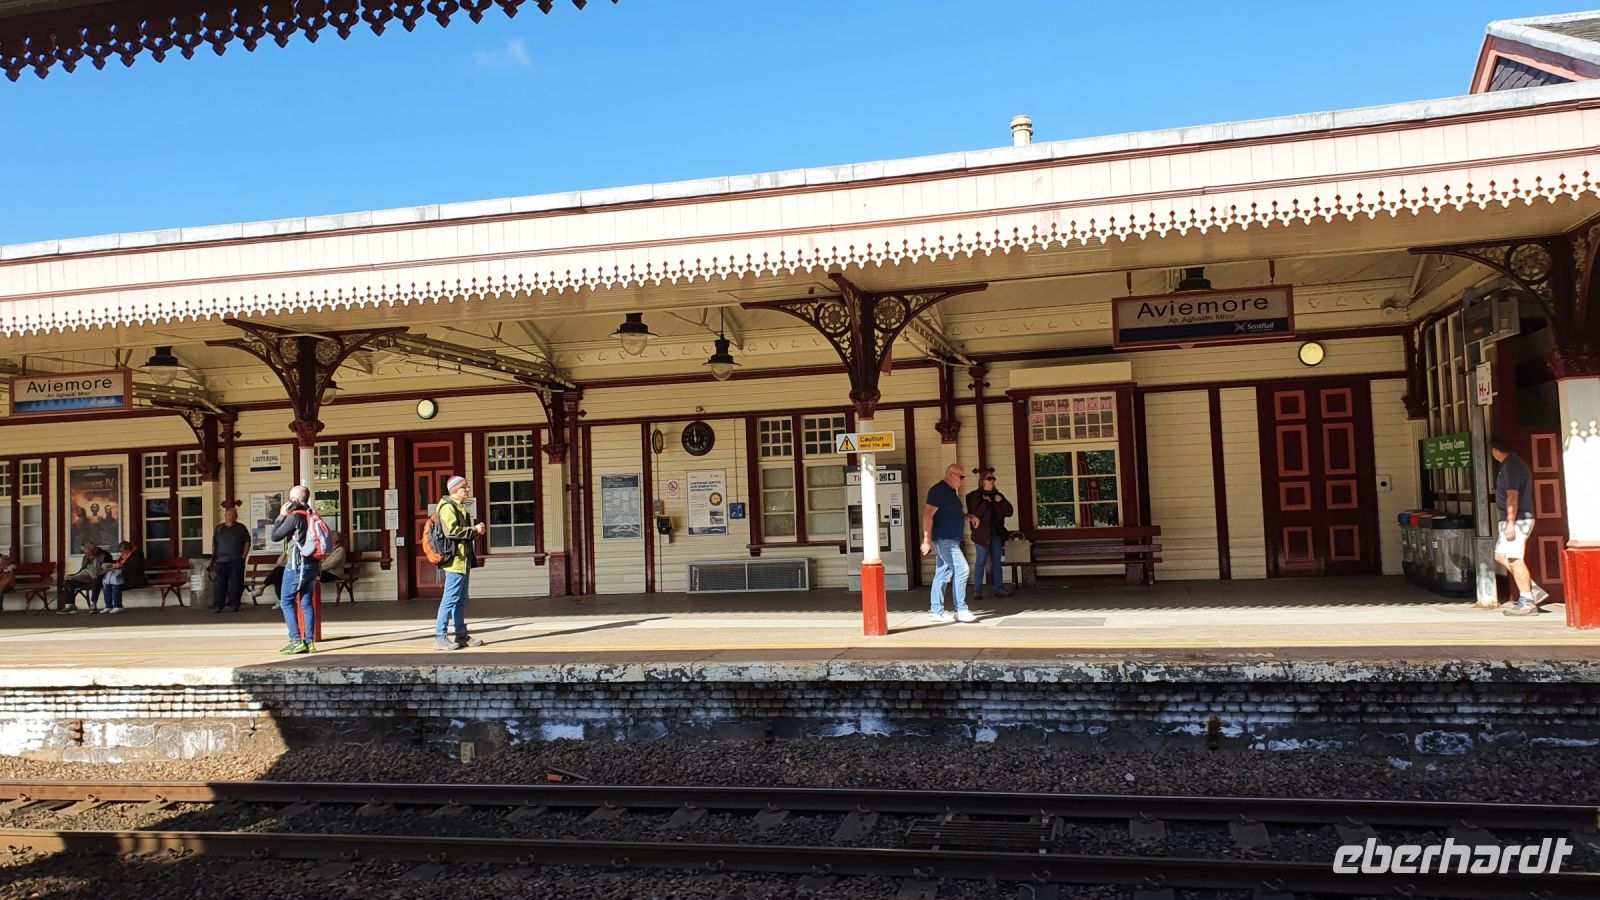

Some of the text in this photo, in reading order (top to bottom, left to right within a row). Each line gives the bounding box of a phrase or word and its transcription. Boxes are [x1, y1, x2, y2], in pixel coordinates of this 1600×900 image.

[1137, 297, 1269, 319] Aviemore
[1247, 322, 1275, 330] ScotRail
[26, 378, 113, 394] Aviemore
[1439, 440, 1454, 452] Recycling
